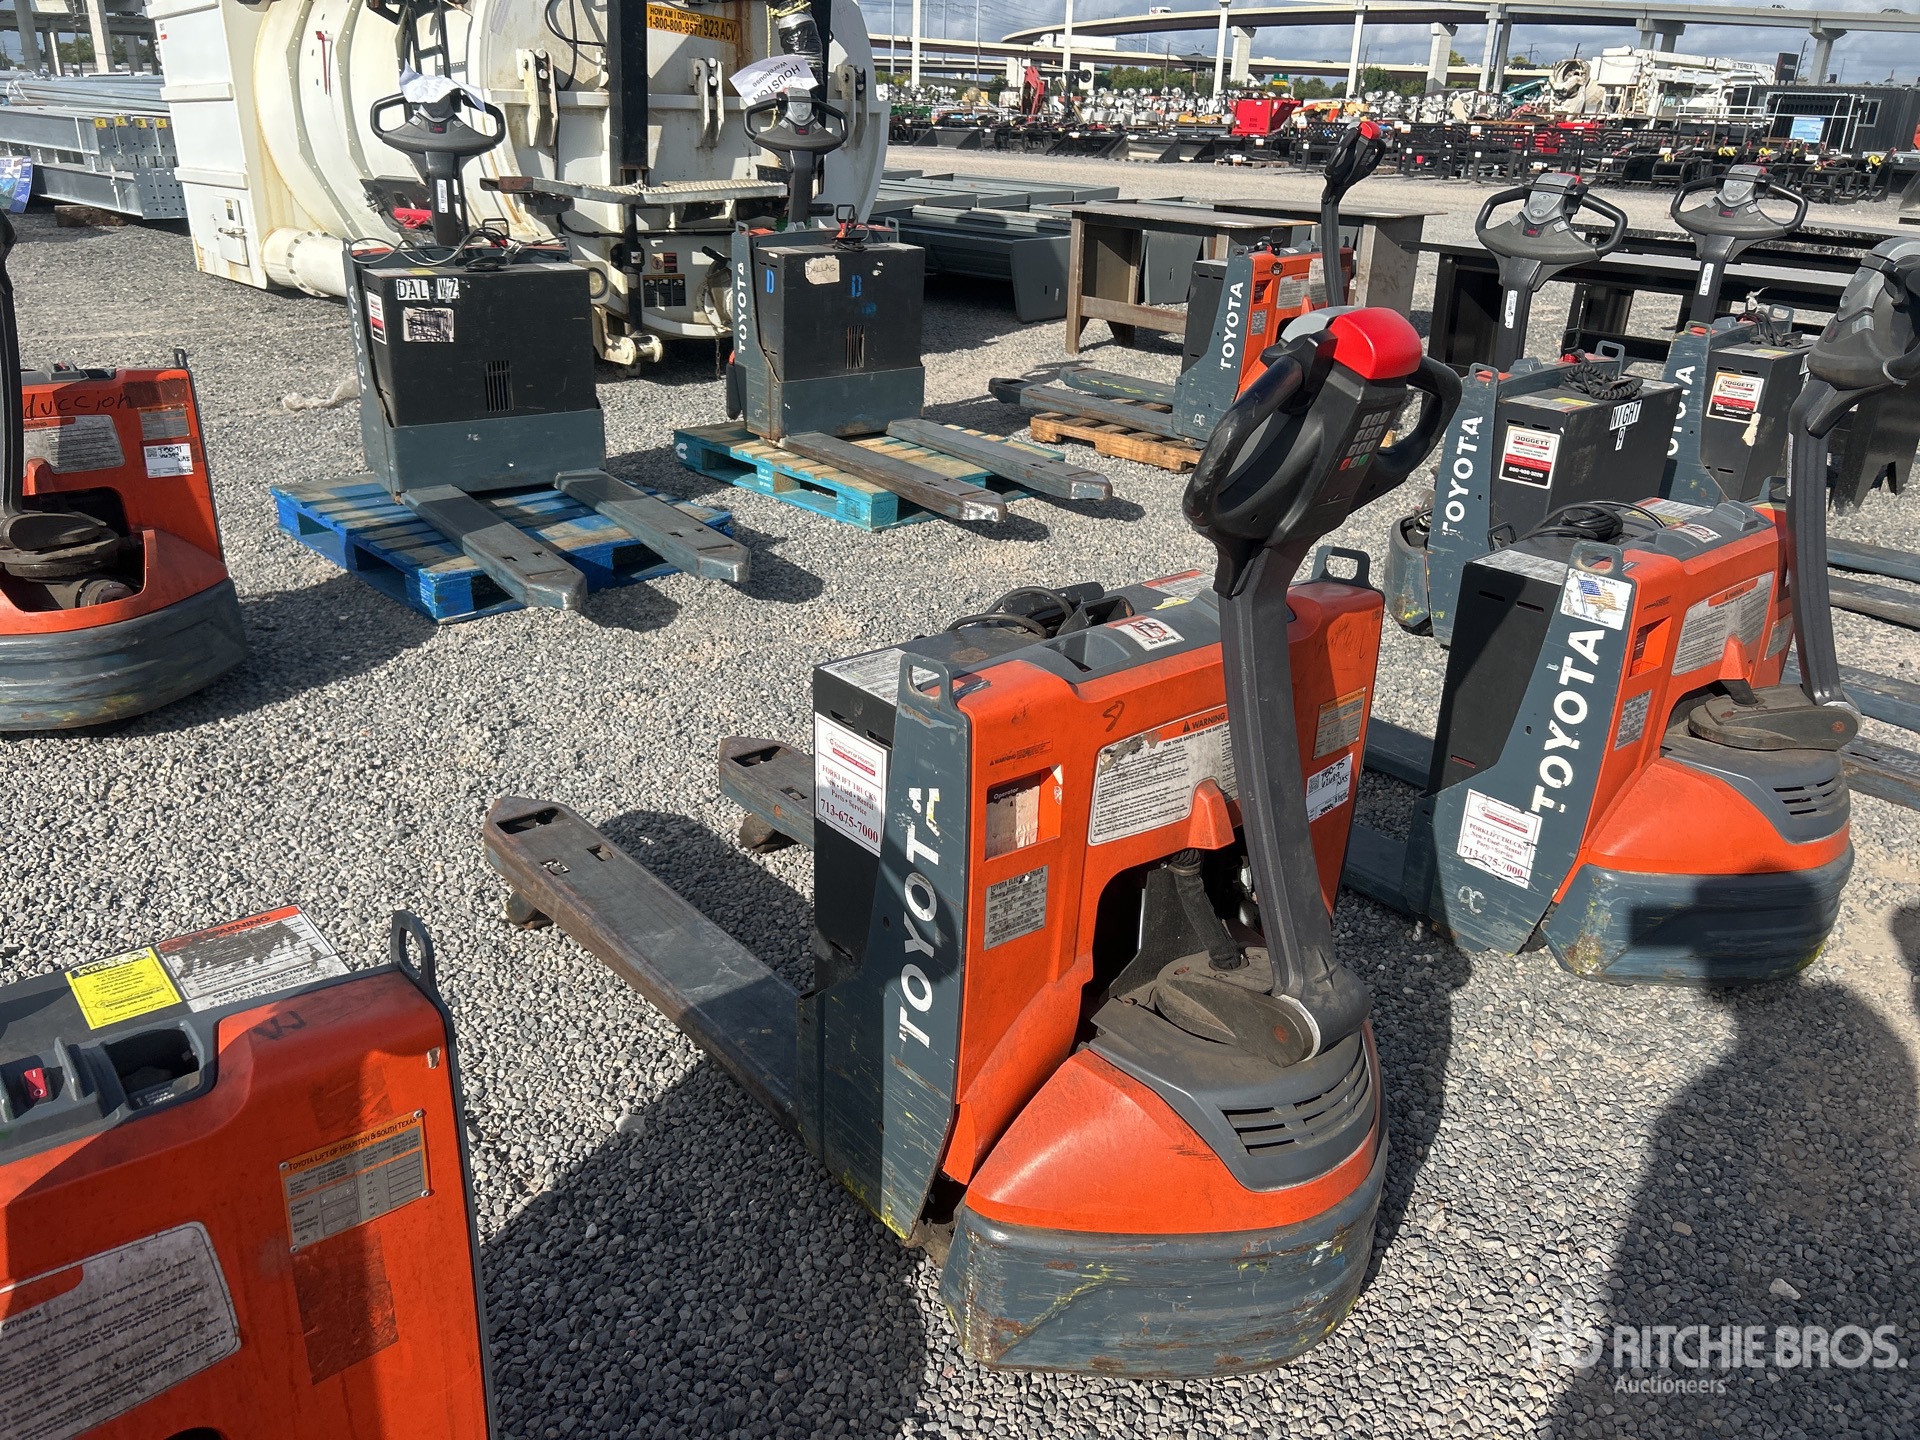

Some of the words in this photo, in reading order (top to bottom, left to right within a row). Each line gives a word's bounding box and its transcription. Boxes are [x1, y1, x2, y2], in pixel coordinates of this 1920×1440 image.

[650, 8, 662, 16] HOW
[662, 9, 673, 17] AM
[704, 18, 719, 38] 923
[720, 21, 737, 41] ACV
[752, 61, 788, 88] Warehouse
[806, 264, 837, 275] DALLAS
[398, 280, 427, 298] DAL
[737, 262, 748, 353] TOYOTA
[349, 285, 367, 394] TOYOTA
[1220, 282, 1244, 370] TOYOTA
[1610, 400, 1642, 430] NIGHT
[1442, 416, 1483, 540] TOYOTA
[1192, 713, 1225, 729] WARNING
[1530, 630, 1604, 813] TOYOTA
[822, 765, 851, 787] FORKLIFT
[853, 780, 877, 802] TRUCKS
[994, 787, 1019, 799] Operator
[831, 789, 845, 802] Parts
[848, 801, 867, 816] Service
[821, 799, 878, 843] 713-675-7000
[213, 914, 271, 937] ARNING
[212, 984, 249, 999] SERVICE
[218, 994, 237, 1004] NOT
[288, 1157, 314, 1171] TOYOTA
[314, 1151, 329, 1162] LIFT
[330, 1148, 339, 1157] OF
[339, 1135, 370, 1153] HOUSTON
[376, 1124, 399, 1138] SOUTH
[398, 1117, 417, 1129] TEXAS
[1, 1309, 43, 1332] OTHERS
